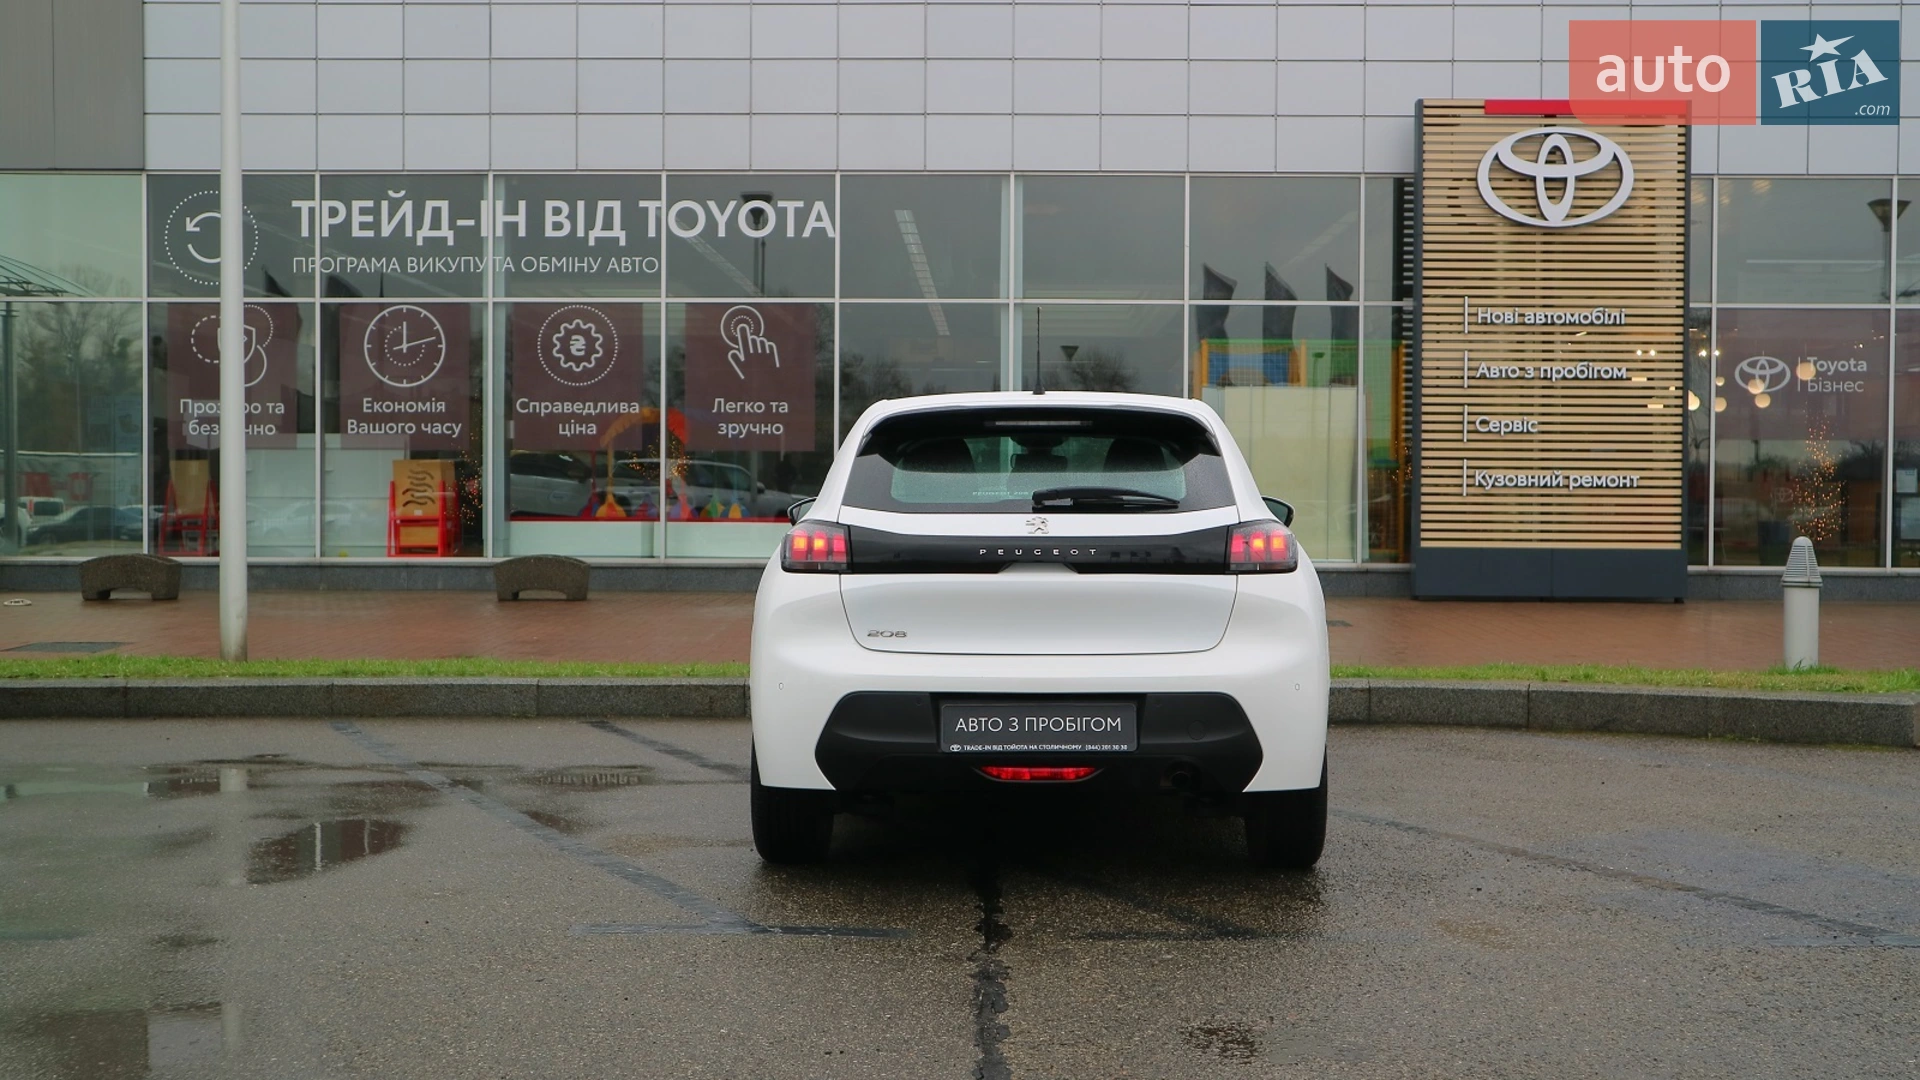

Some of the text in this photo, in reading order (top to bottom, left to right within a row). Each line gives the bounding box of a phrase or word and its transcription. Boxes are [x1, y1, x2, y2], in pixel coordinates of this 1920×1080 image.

[291, 189, 836, 246] ТРЕЙД-ІН ВІД TOYOTA
[293, 256, 659, 274] ПРОГРАМА ВИКУПУ ТА ОБМІНУ АВТО
[1477, 307, 1626, 325] Нові автомобілі
[1476, 362, 1628, 382] Авто з пробігом
[1807, 356, 1868, 375] Toyota
[1807, 377, 1864, 392] Бізнес
[266, 402, 285, 414] та
[363, 397, 446, 413] Економія
[516, 398, 640, 417] Справедлива
[712, 397, 789, 413] Легко та
[347, 418, 462, 438] Вашого часу
[558, 419, 597, 437] ціна
[717, 422, 784, 438] зручно
[1475, 416, 1538, 436] Сервіс
[1475, 470, 1640, 491] Кузовний ремонт
[979, 548, 1097, 556] PEUGEOT
[867, 629, 907, 638] 208
[954, 717, 1122, 732] АВТО З ПРОБІГОМ
